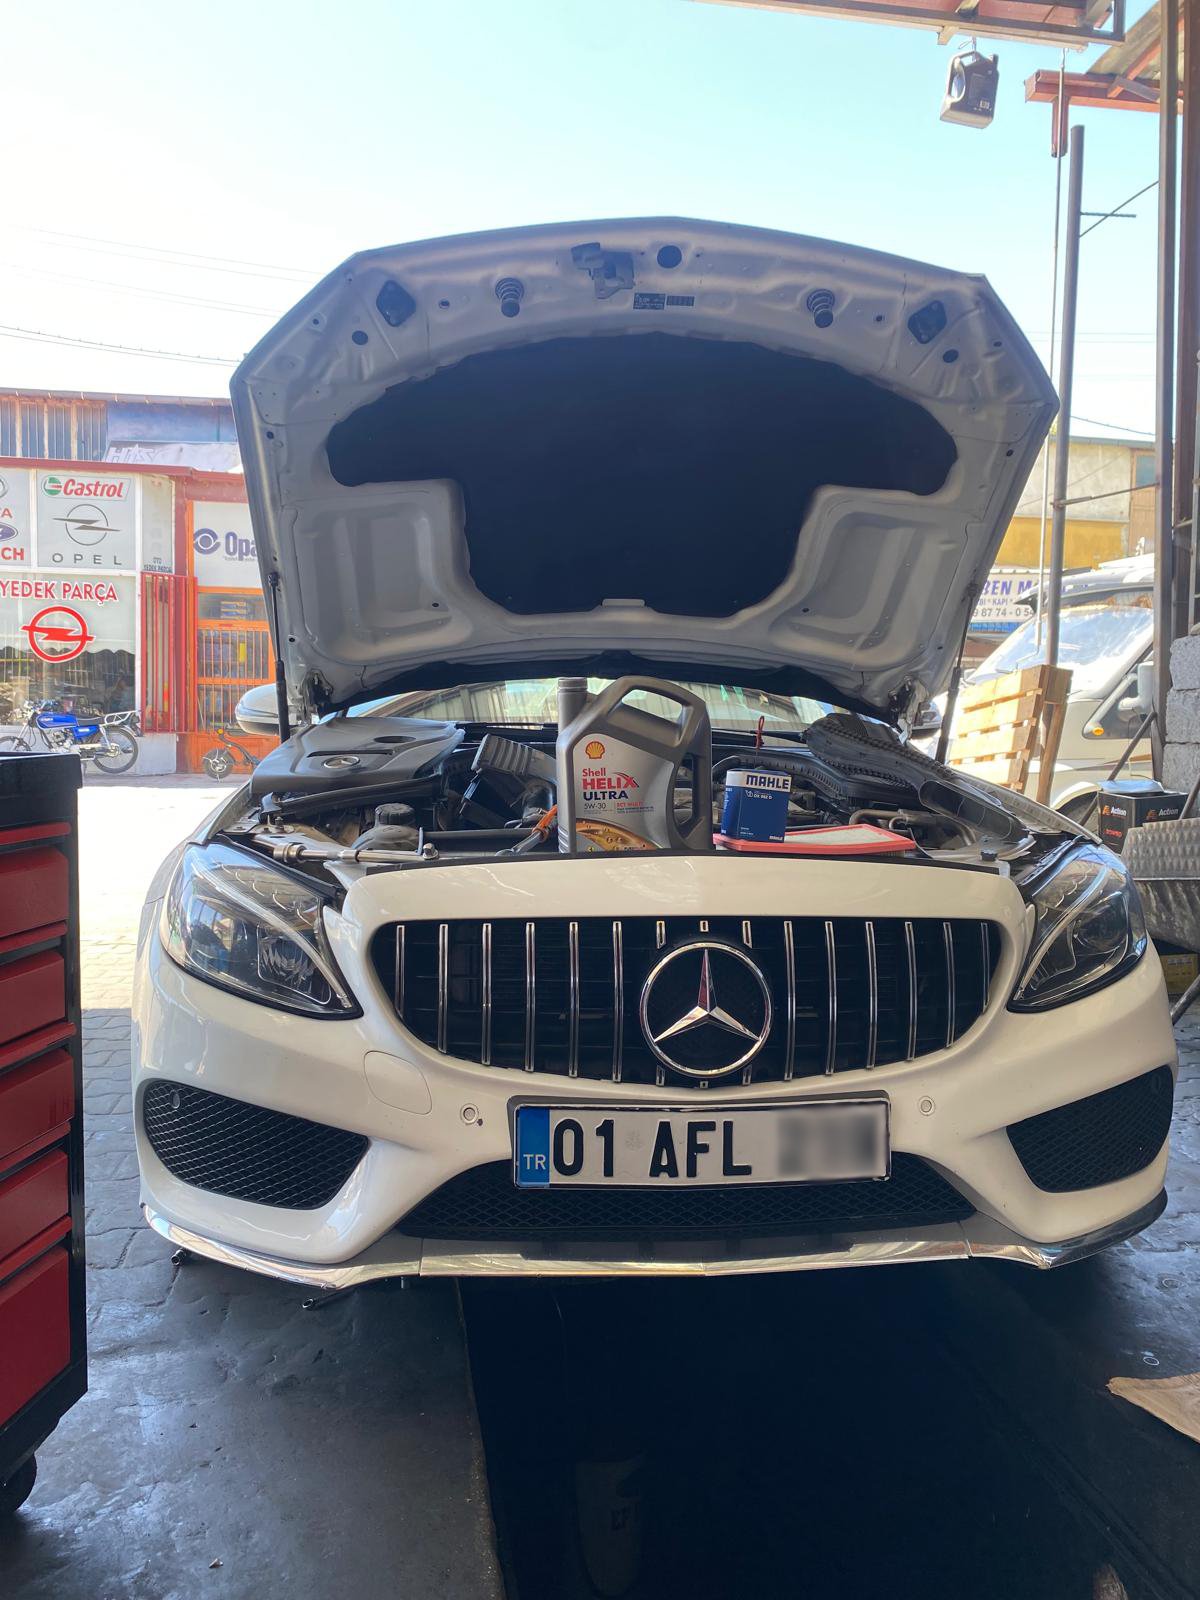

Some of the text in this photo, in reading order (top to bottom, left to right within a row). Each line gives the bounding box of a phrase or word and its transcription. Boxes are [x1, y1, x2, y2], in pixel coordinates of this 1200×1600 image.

[63, 479, 123, 498] Castrol
[52, 552, 122, 566] OPEL
[0, 581, 118, 603] YEDEK PARÇA
[582, 768, 606, 777] Shell
[582, 772, 640, 790] HELIX
[746, 775, 790, 790] MAHLE
[583, 790, 629, 801] ULTRA
[584, 802, 606, 810] 5W-30
[1110, 806, 1127, 816] Action
[1158, 808, 1179, 817] Action
[523, 1154, 546, 1170] TR
[553, 1118, 614, 1177] 01
[649, 1120, 752, 1177] AFL
